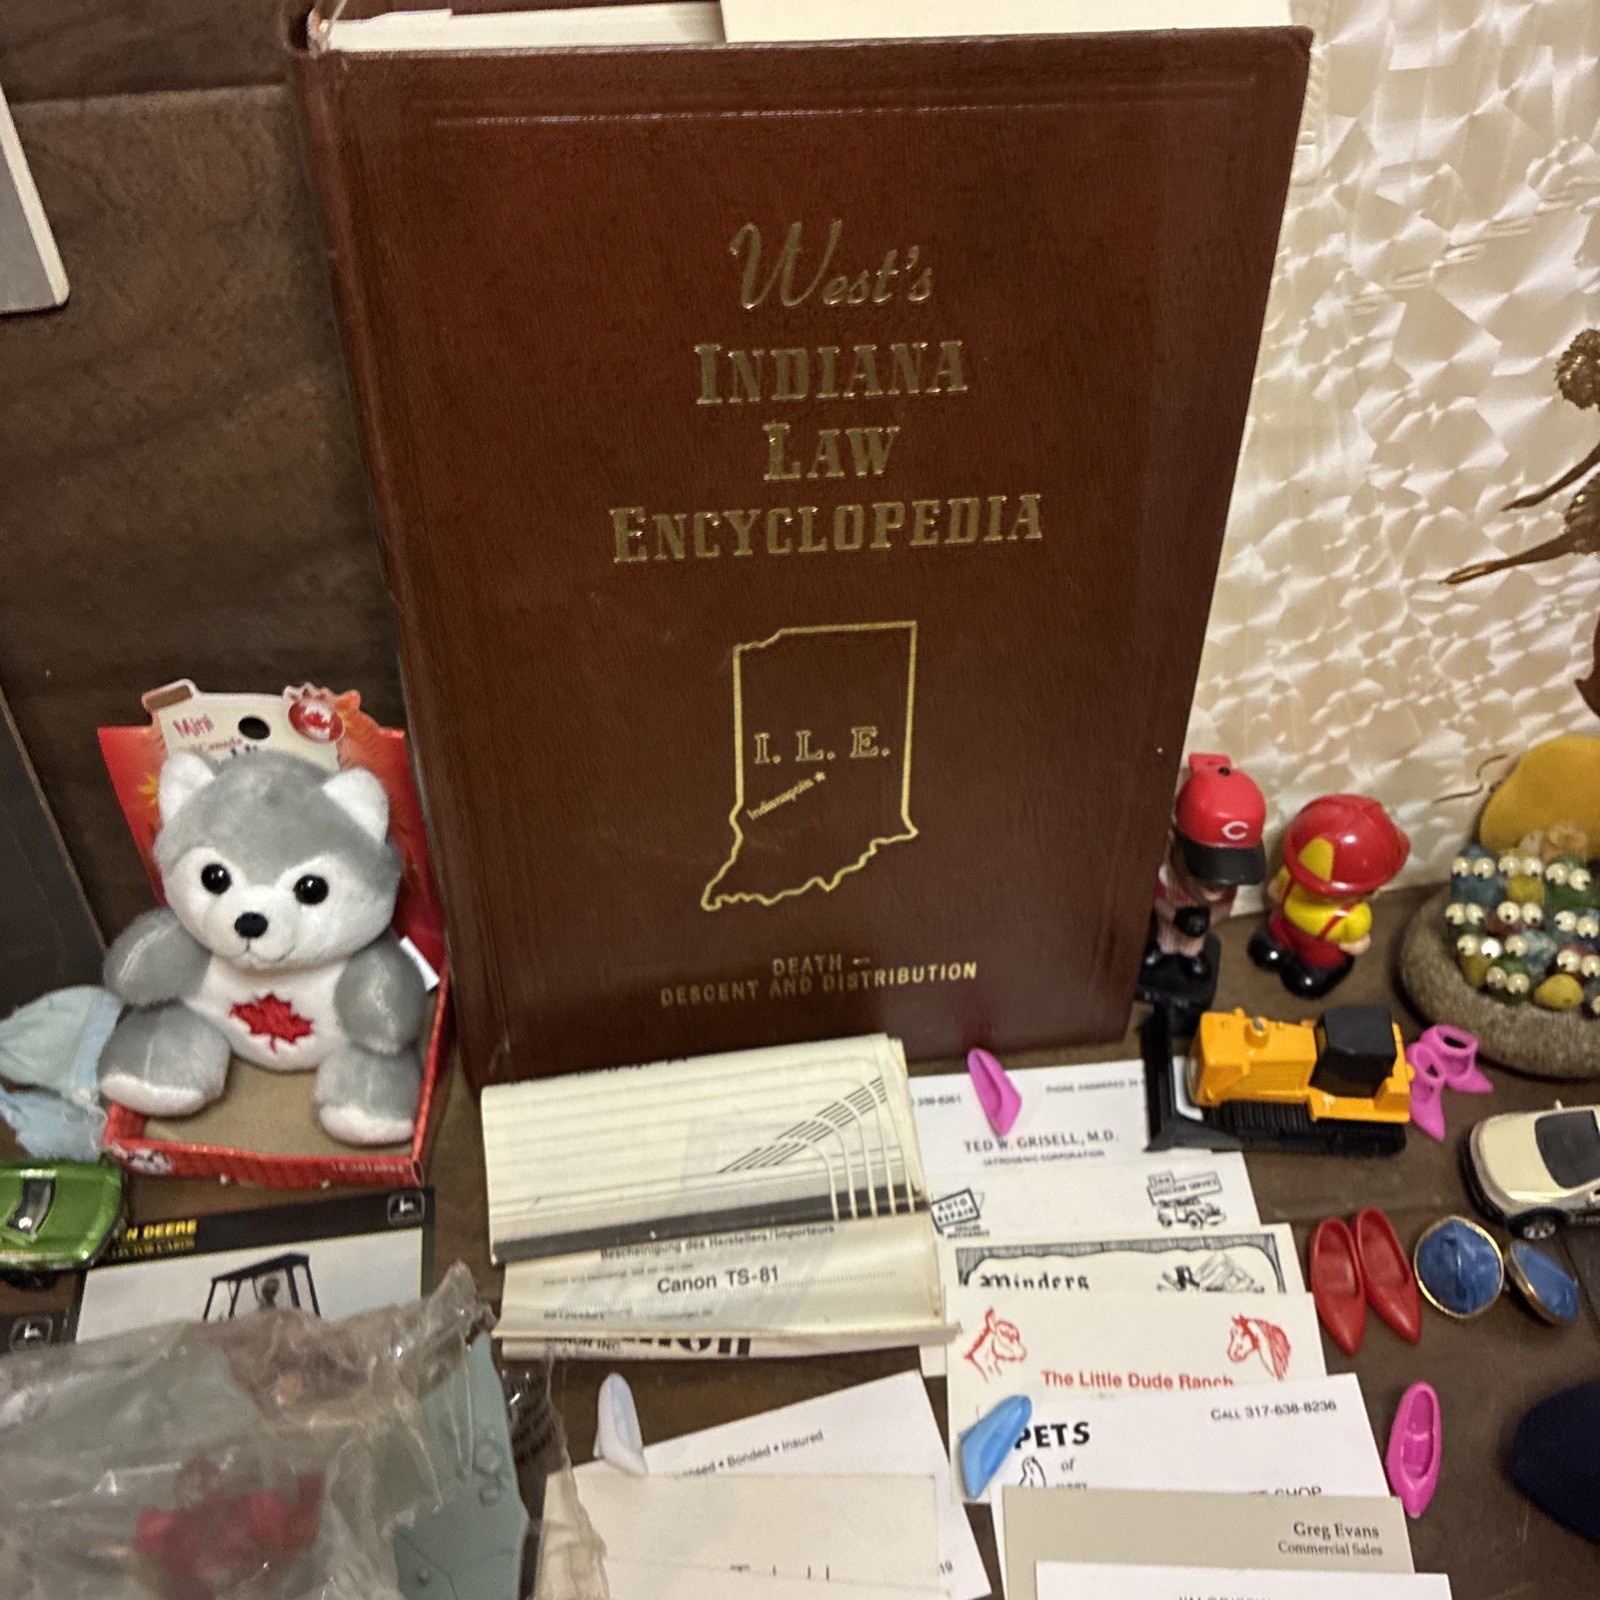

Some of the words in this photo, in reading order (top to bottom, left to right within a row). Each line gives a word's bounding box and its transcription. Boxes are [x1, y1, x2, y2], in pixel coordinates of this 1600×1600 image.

[730, 220, 934, 309] West's
[694, 340, 968, 404] INDIANA
[763, 421, 900, 480] LAW
[609, 494, 1043, 563] ENCYCLOPEDIA
[1222, 821, 1249, 840] C
[772, 953, 843, 977] DEATH
[660, 979, 760, 1008] DESCENT
[768, 976, 813, 998] AND
[822, 961, 978, 993] DISTRIBUTION
[964, 1139, 994, 1154] TED
[657, 1274, 717, 1294] Canon
[725, 1264, 780, 1287] TS-81
[1042, 1370, 1074, 1388] The
[1079, 1371, 1123, 1389] Little
[1128, 1373, 1174, 1390] Dude
[1179, 1374, 1234, 1390] Ranch
[727, 1444, 772, 1467] Bonded
[781, 1429, 824, 1451] Insured
[1061, 1456, 1076, 1473] of
[1293, 1521, 1331, 1541] Greg
[1335, 1523, 1380, 1538] Evans
[1277, 1542, 1350, 1556] Commercial
[1352, 1543, 1384, 1557] Sales
